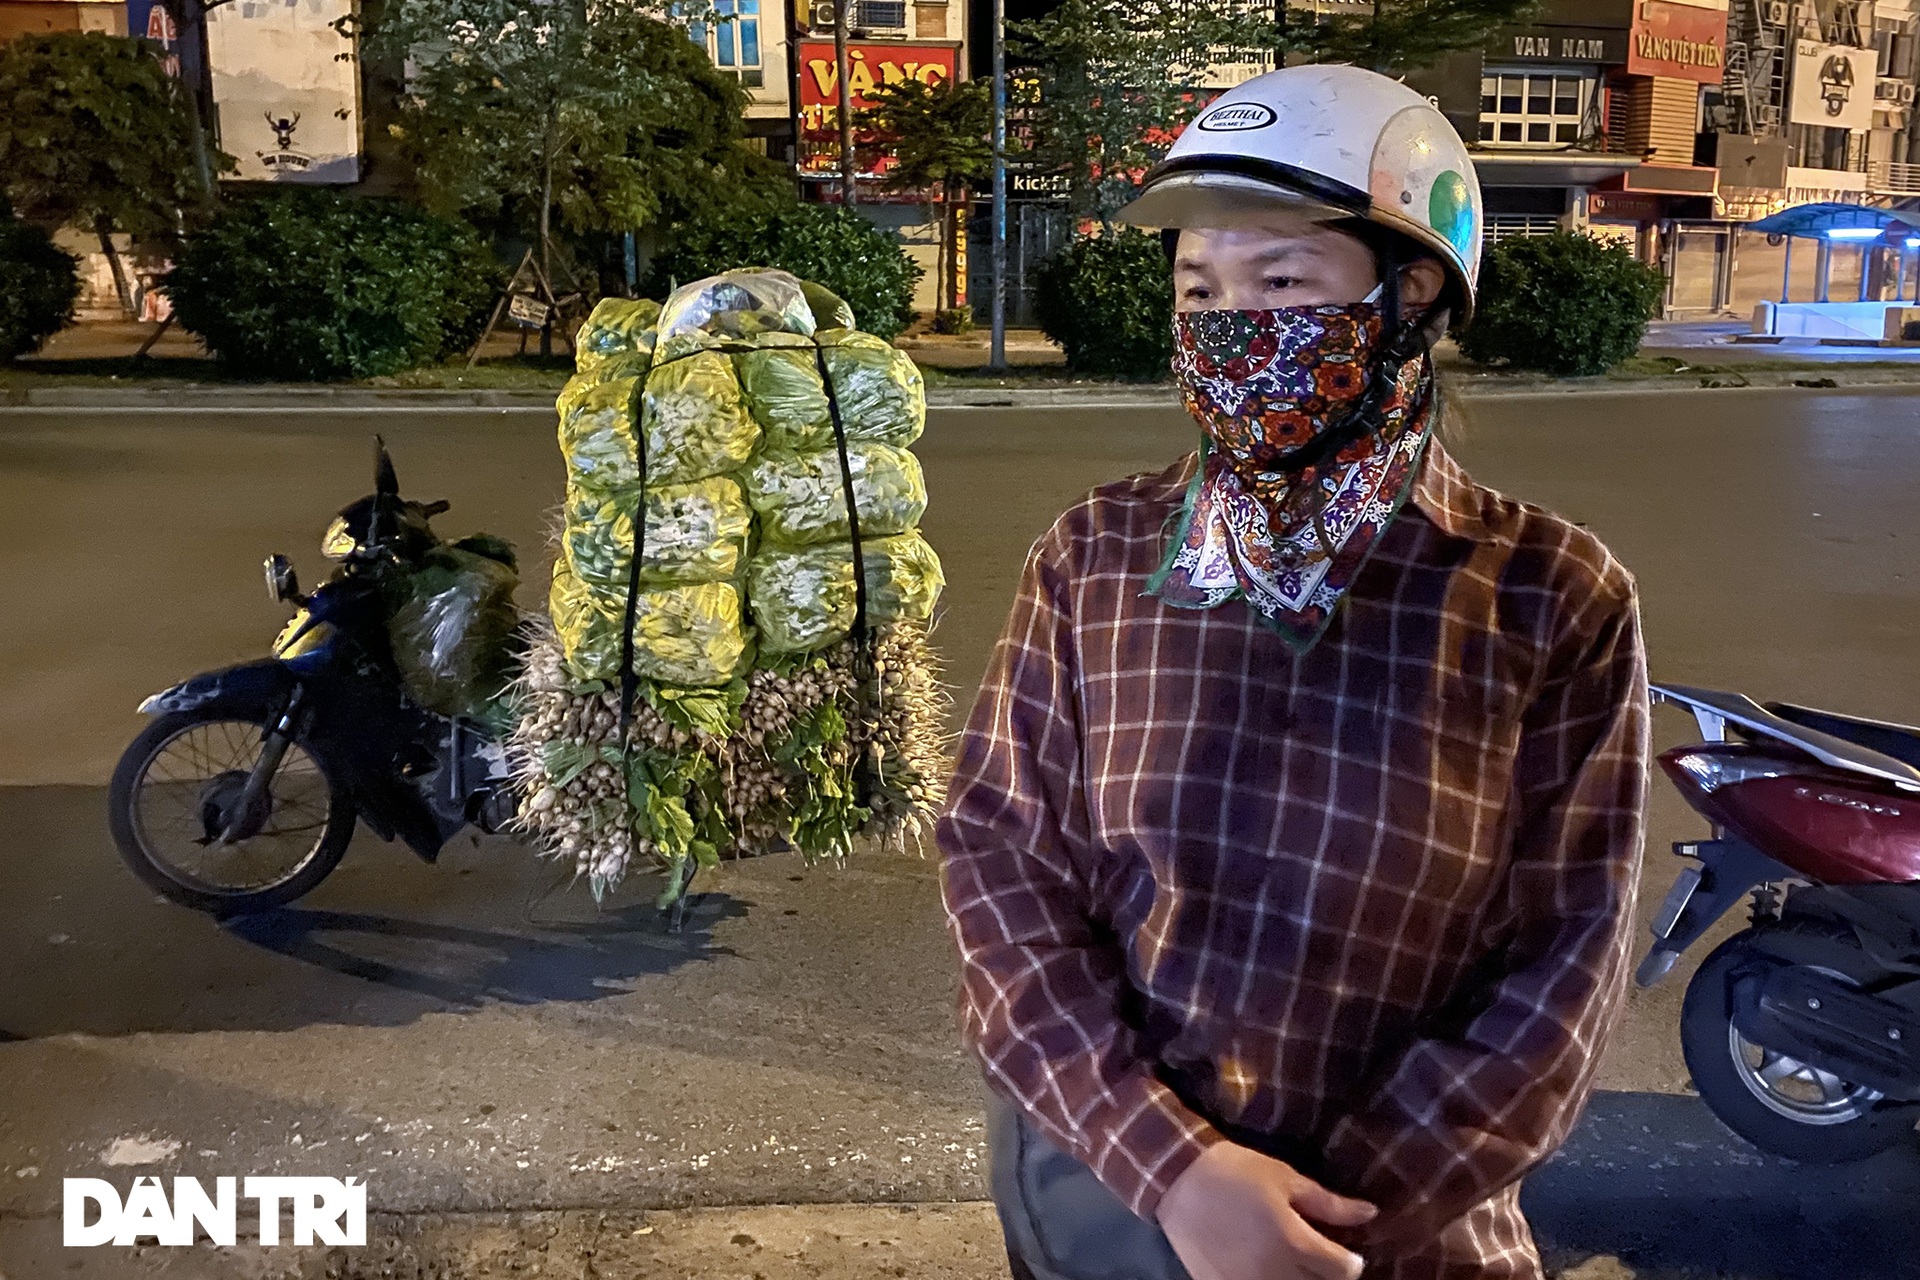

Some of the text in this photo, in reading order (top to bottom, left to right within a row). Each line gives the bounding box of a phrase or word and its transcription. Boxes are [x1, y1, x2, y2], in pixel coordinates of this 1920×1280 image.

[1562, 38, 1603, 59] NAM
[1637, 29, 1670, 61] VÀNG
[1798, 45, 1818, 57] CLUB
[808, 50, 947, 98] VÀNG
[1210, 109, 1264, 121] BEZTHAI
